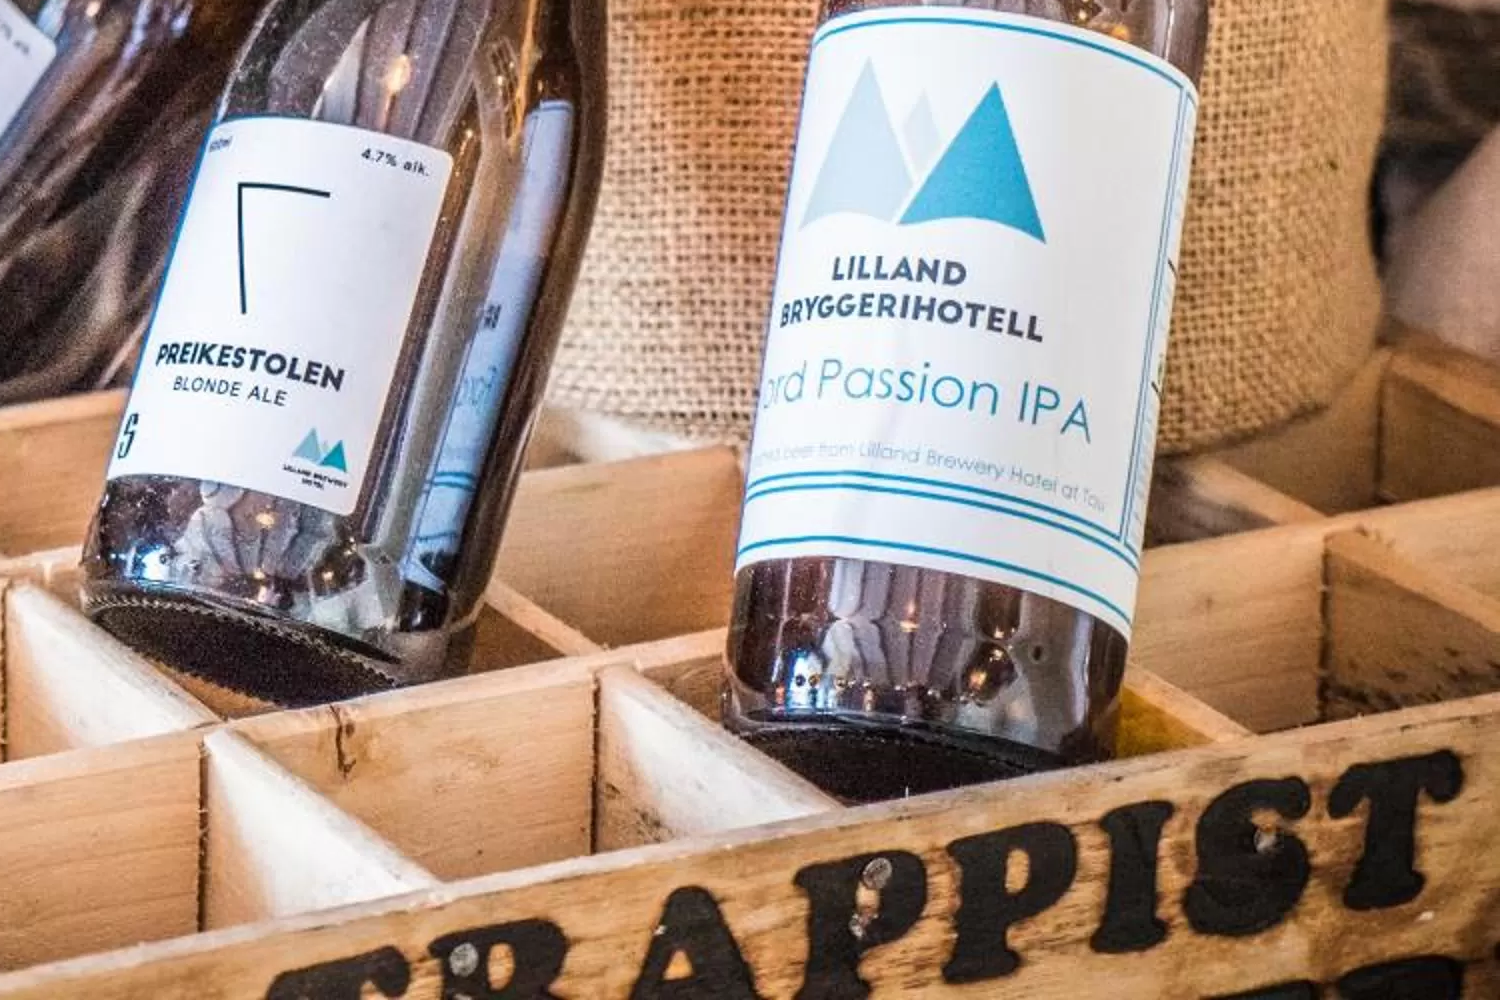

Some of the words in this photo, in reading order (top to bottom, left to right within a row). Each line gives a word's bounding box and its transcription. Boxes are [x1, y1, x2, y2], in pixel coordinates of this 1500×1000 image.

[832, 256, 967, 286] LILLAND
[780, 293, 1043, 343] BRYGGERIHOTELL
[156, 342, 345, 392] PREIKESTOLEN
[173, 376, 241, 397] BLONDE
[248, 385, 288, 406] ALE
[818, 359, 999, 415] Passion
[1018, 380, 1091, 444] IPA
[859, 440, 919, 463] Lilland
[926, 449, 1004, 480] Brewery
[1009, 463, 1057, 492] Hotel
[1061, 483, 1082, 499] at
